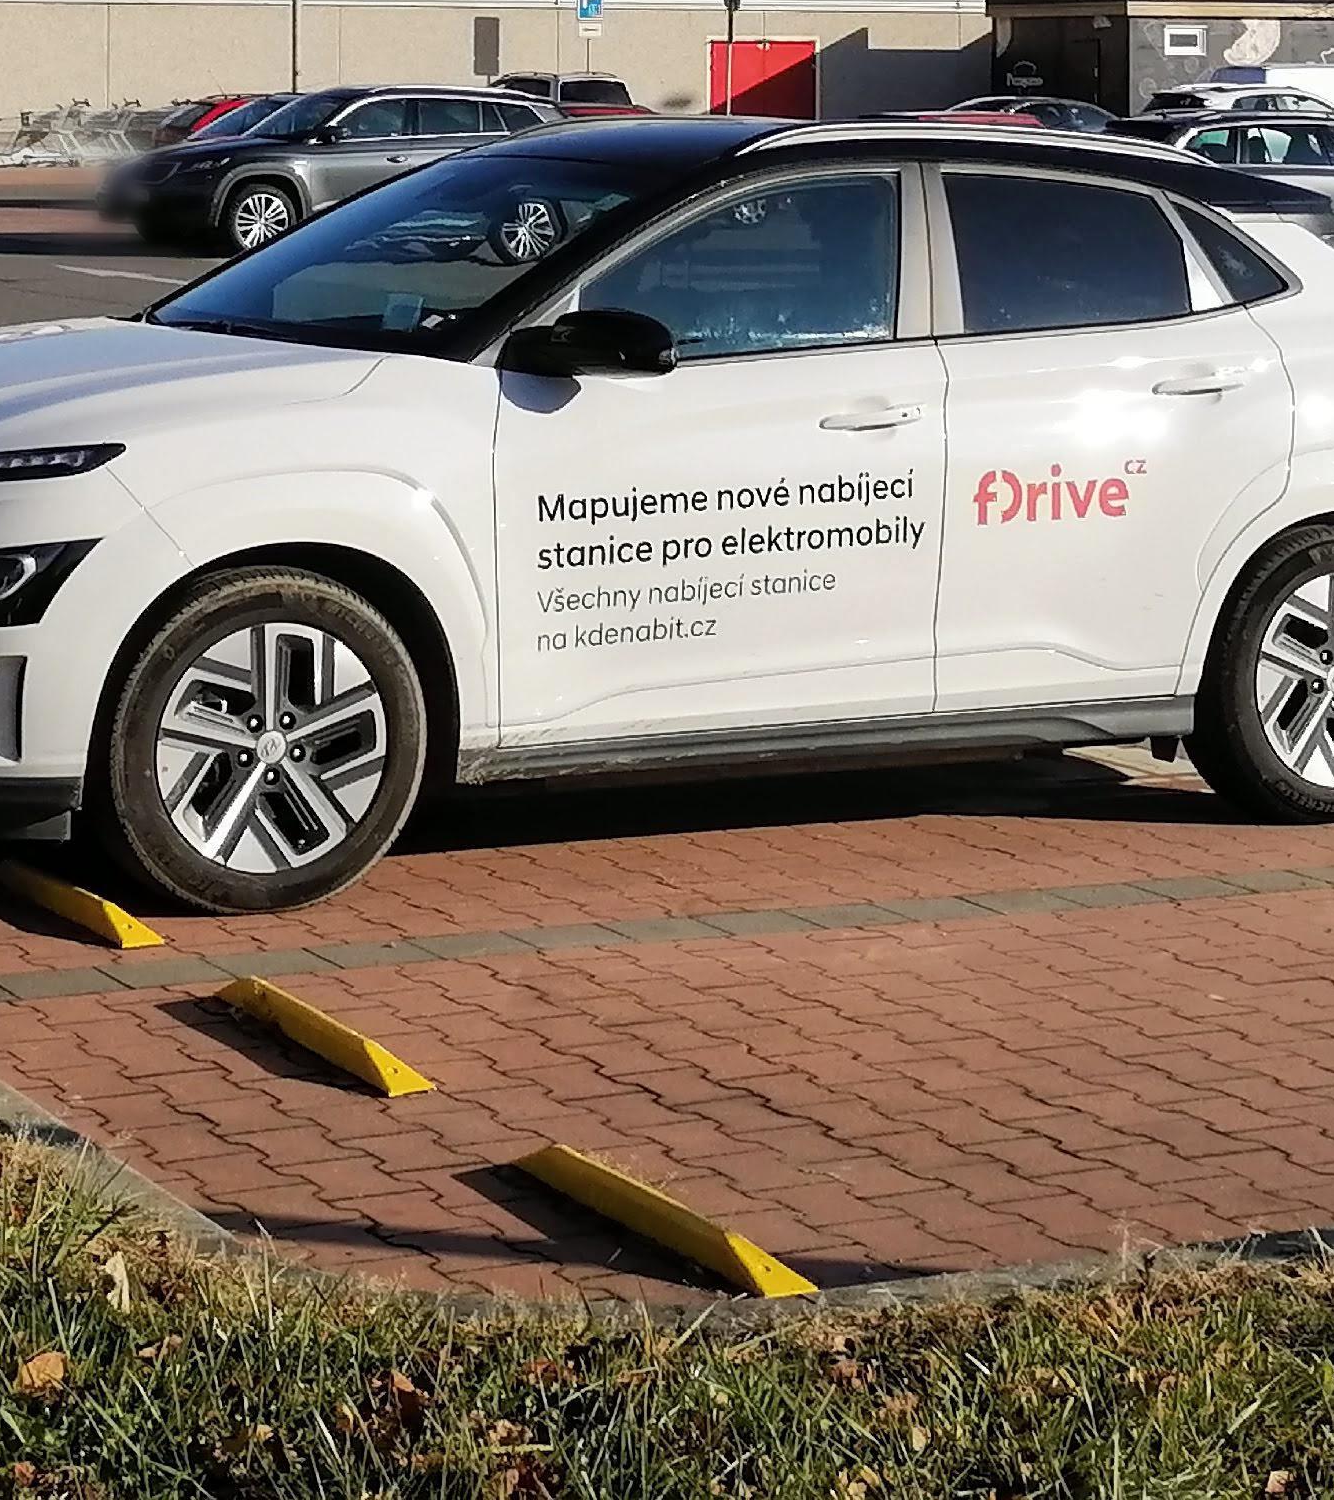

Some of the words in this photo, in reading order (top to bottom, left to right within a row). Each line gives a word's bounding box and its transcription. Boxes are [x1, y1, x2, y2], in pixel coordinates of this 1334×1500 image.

[537, 485, 708, 526] Mapujeme
[717, 476, 791, 511] nové
[798, 467, 914, 508] nabíjecí
[537, 534, 653, 570] stanice
[662, 536, 713, 569] pro
[721, 515, 927, 556] elektromobily
[536, 585, 641, 614] Všechny
[648, 572, 745, 607] nabíjecí
[749, 573, 836, 596] stanice
[537, 632, 567, 653] na
[574, 615, 717, 649] kdenabit.cz
